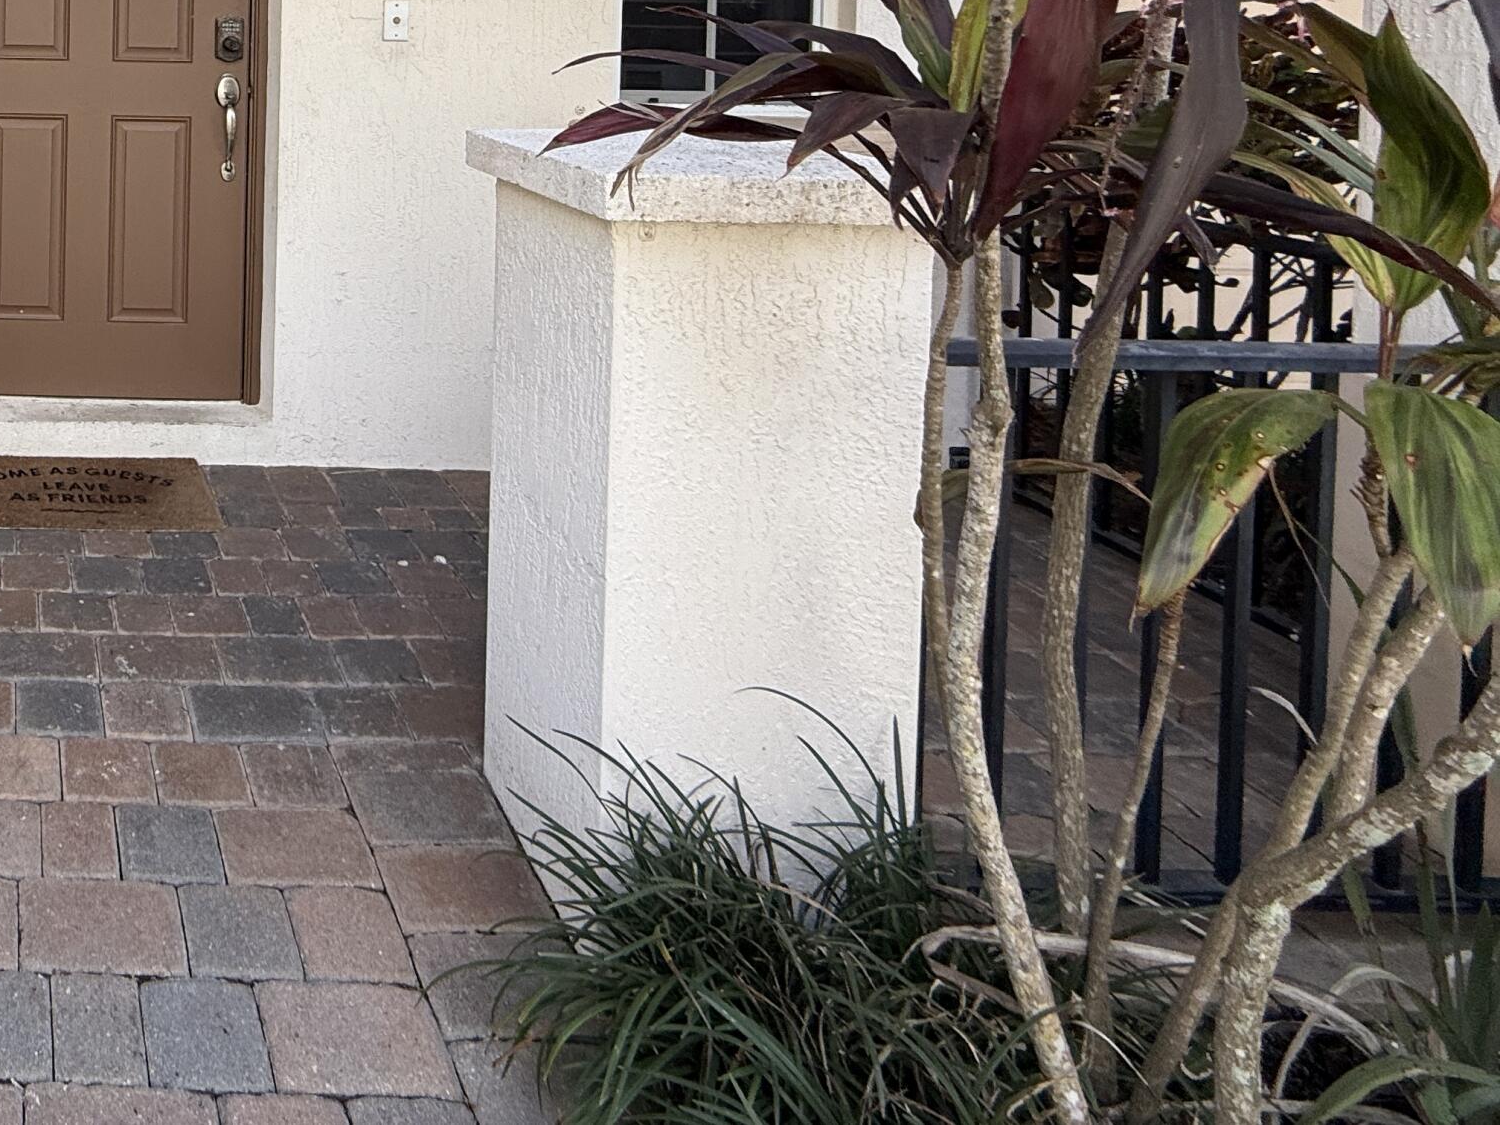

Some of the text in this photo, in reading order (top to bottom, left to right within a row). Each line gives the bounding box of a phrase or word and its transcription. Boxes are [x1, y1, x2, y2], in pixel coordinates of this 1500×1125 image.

[49, 466, 78, 476] AS
[85, 467, 174, 487] GUESTS
[42, 481, 111, 492] LEAVE
[9, 492, 148, 505] AS FRIENDS
